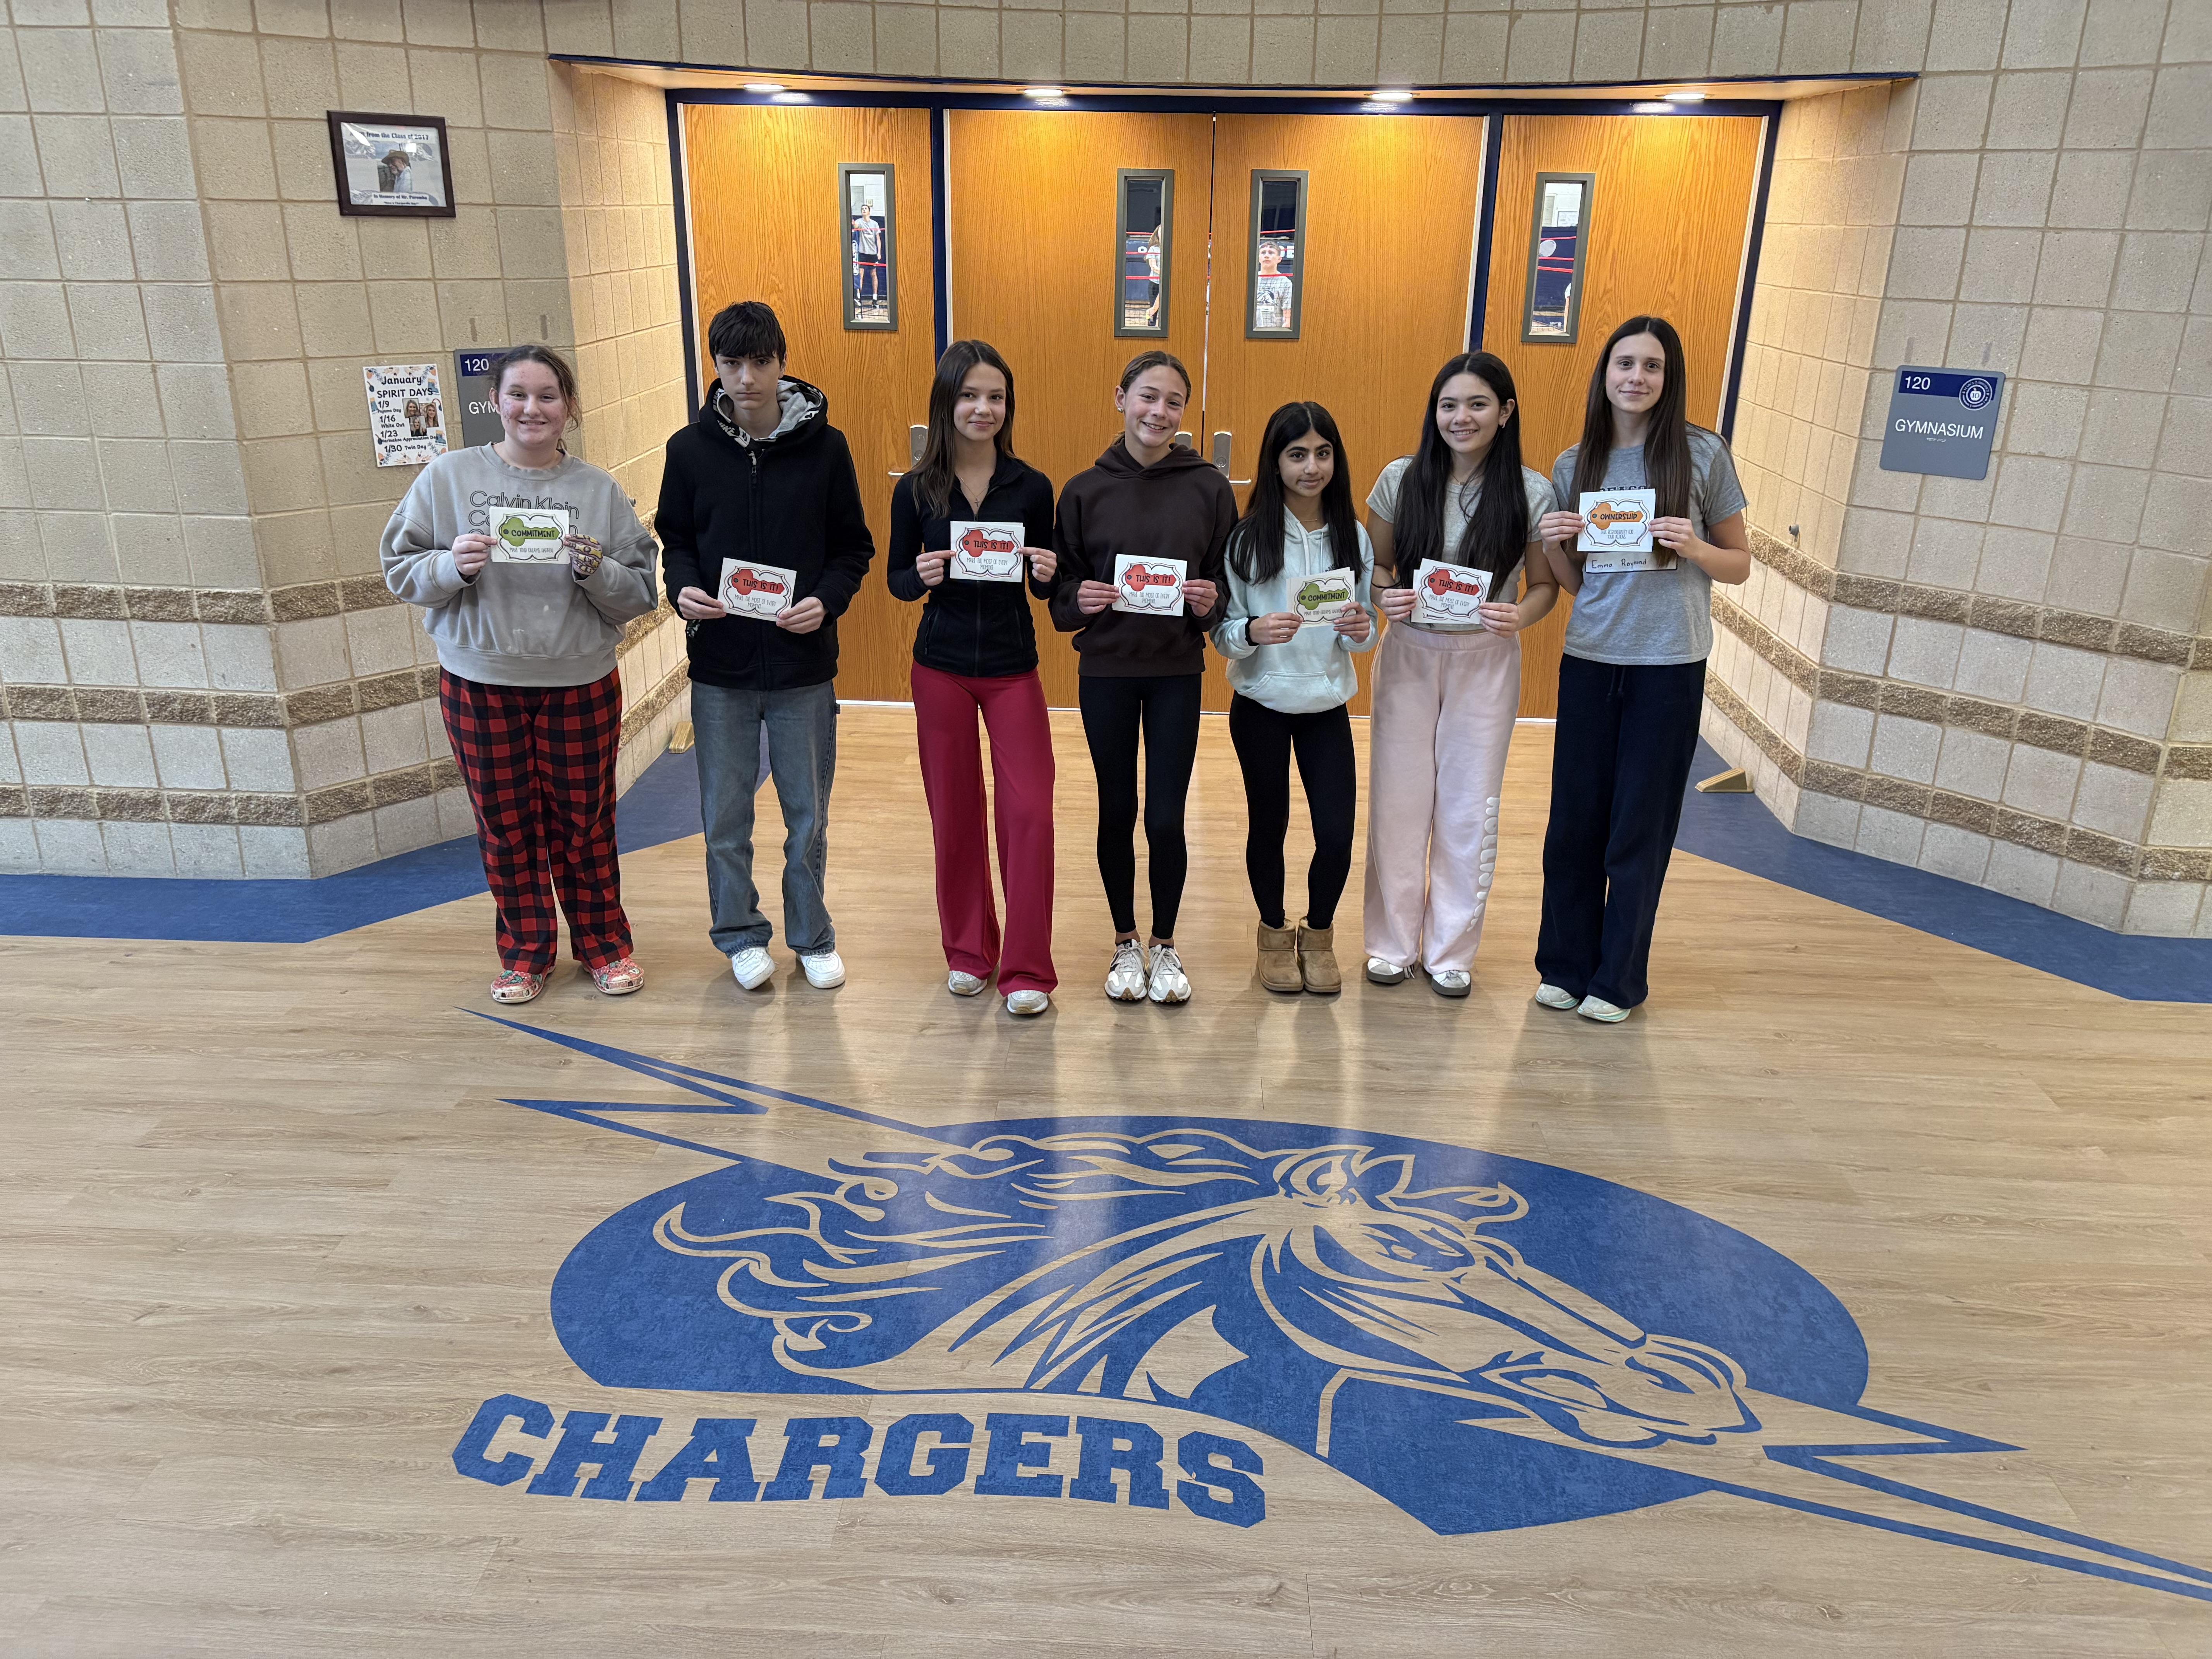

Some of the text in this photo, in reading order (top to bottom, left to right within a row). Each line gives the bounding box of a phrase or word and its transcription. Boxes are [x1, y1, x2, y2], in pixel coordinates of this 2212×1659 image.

[465, 358, 489, 372] 120
[381, 376, 422, 386] January
[1905, 376, 1931, 390] 120
[377, 388, 433, 398] SPIRIT DAYS
[378, 400, 389, 409] 1/9
[380, 415, 396, 424] 1/16
[1895, 419, 1984, 439] GYMNASIUM
[380, 430, 398, 439] 1/23
[384, 445, 402, 453] 1/30
[470, 491, 579, 519] Calvin Klein
[511, 529, 556, 538] COMMITMENT
[974, 540, 988, 549] THIS
[1592, 560, 1613, 568] Emma
[1136, 575, 1150, 583] THIS
[743, 579, 758, 588] THIS
[769, 583, 778, 591] IT!
[1439, 579, 1454, 589] THIS
[1465, 584, 1474, 593] IT!
[1308, 591, 1345, 601] COMMITMENT
[451, 1393, 1267, 1529] CHARGERS
